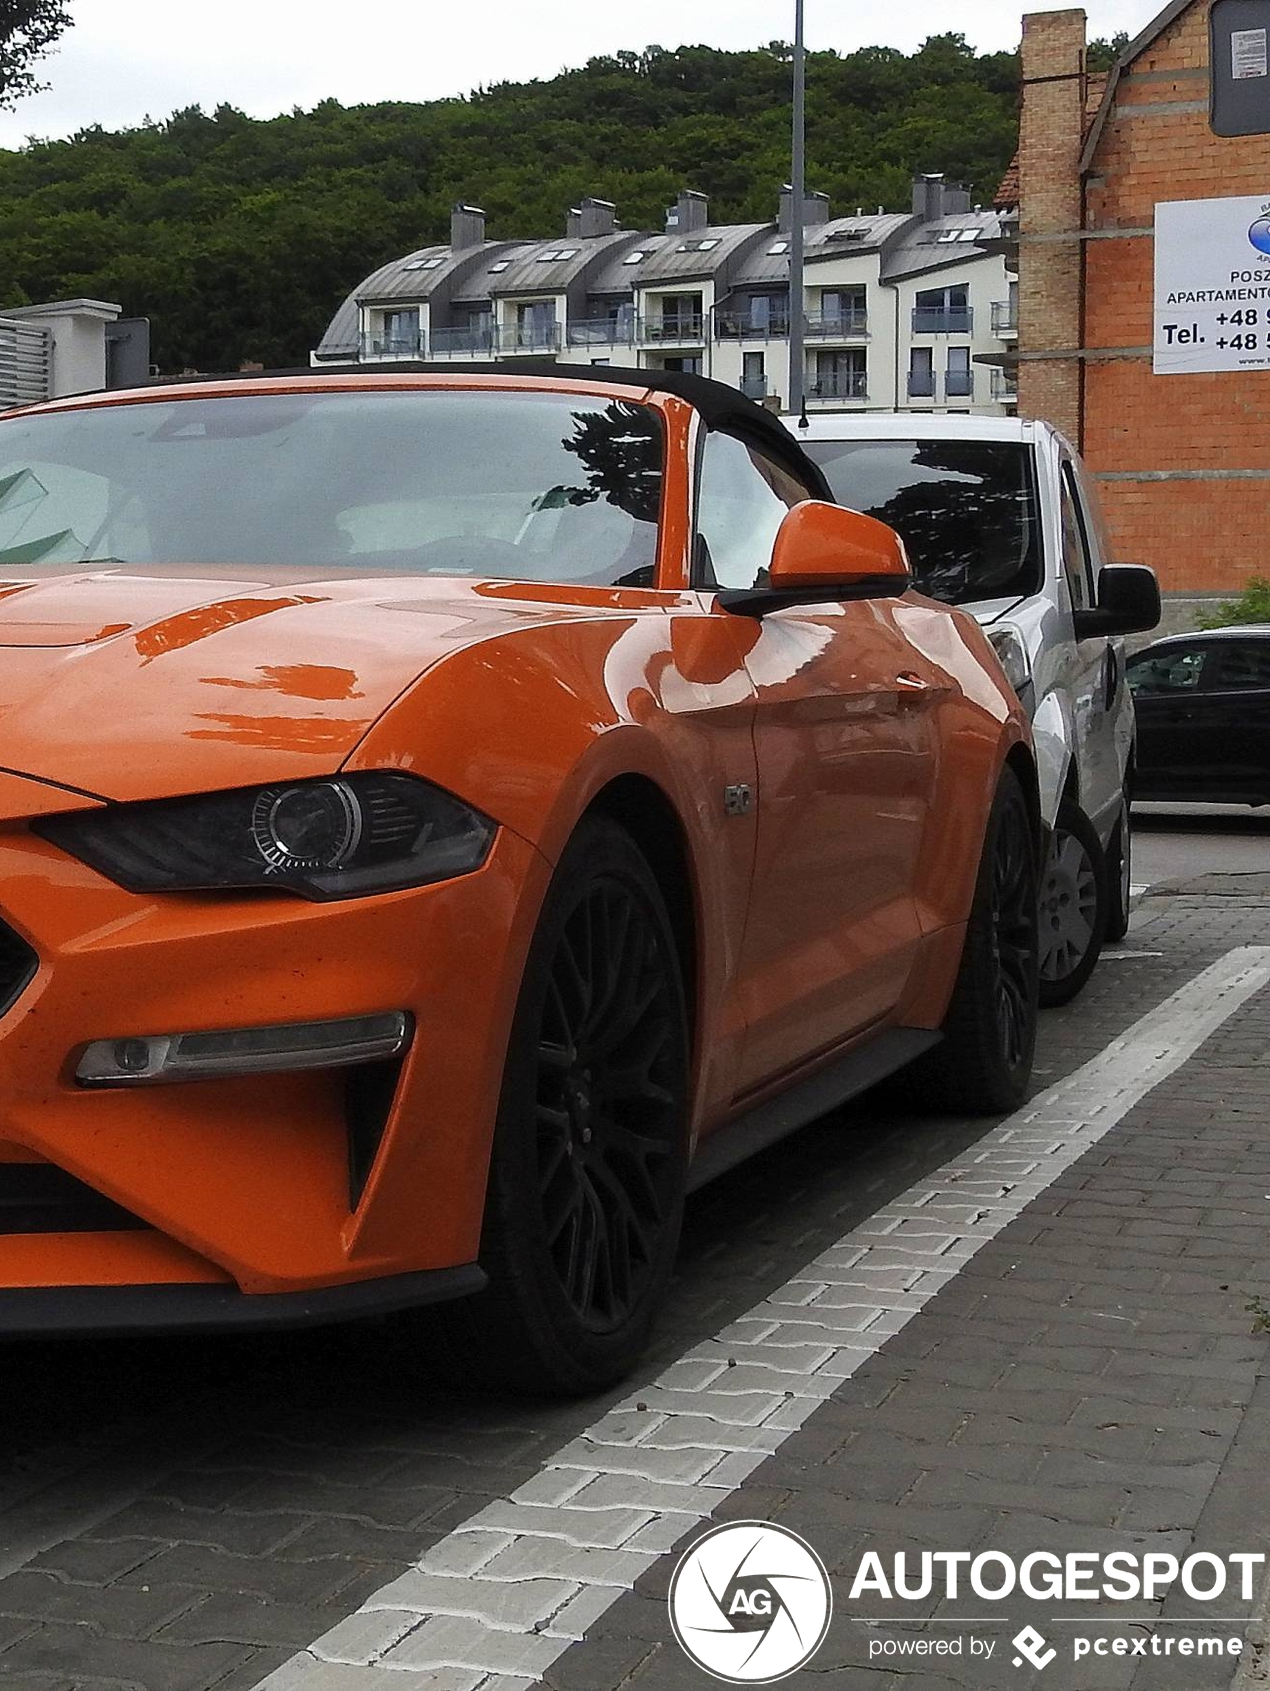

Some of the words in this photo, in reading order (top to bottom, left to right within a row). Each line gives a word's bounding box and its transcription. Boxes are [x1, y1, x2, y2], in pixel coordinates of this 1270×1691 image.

[1166, 286, 1270, 304] APARTAMENT
[1216, 308, 1258, 326] +48
[1162, 323, 1205, 345] Tel.
[1216, 333, 1258, 350] +48
